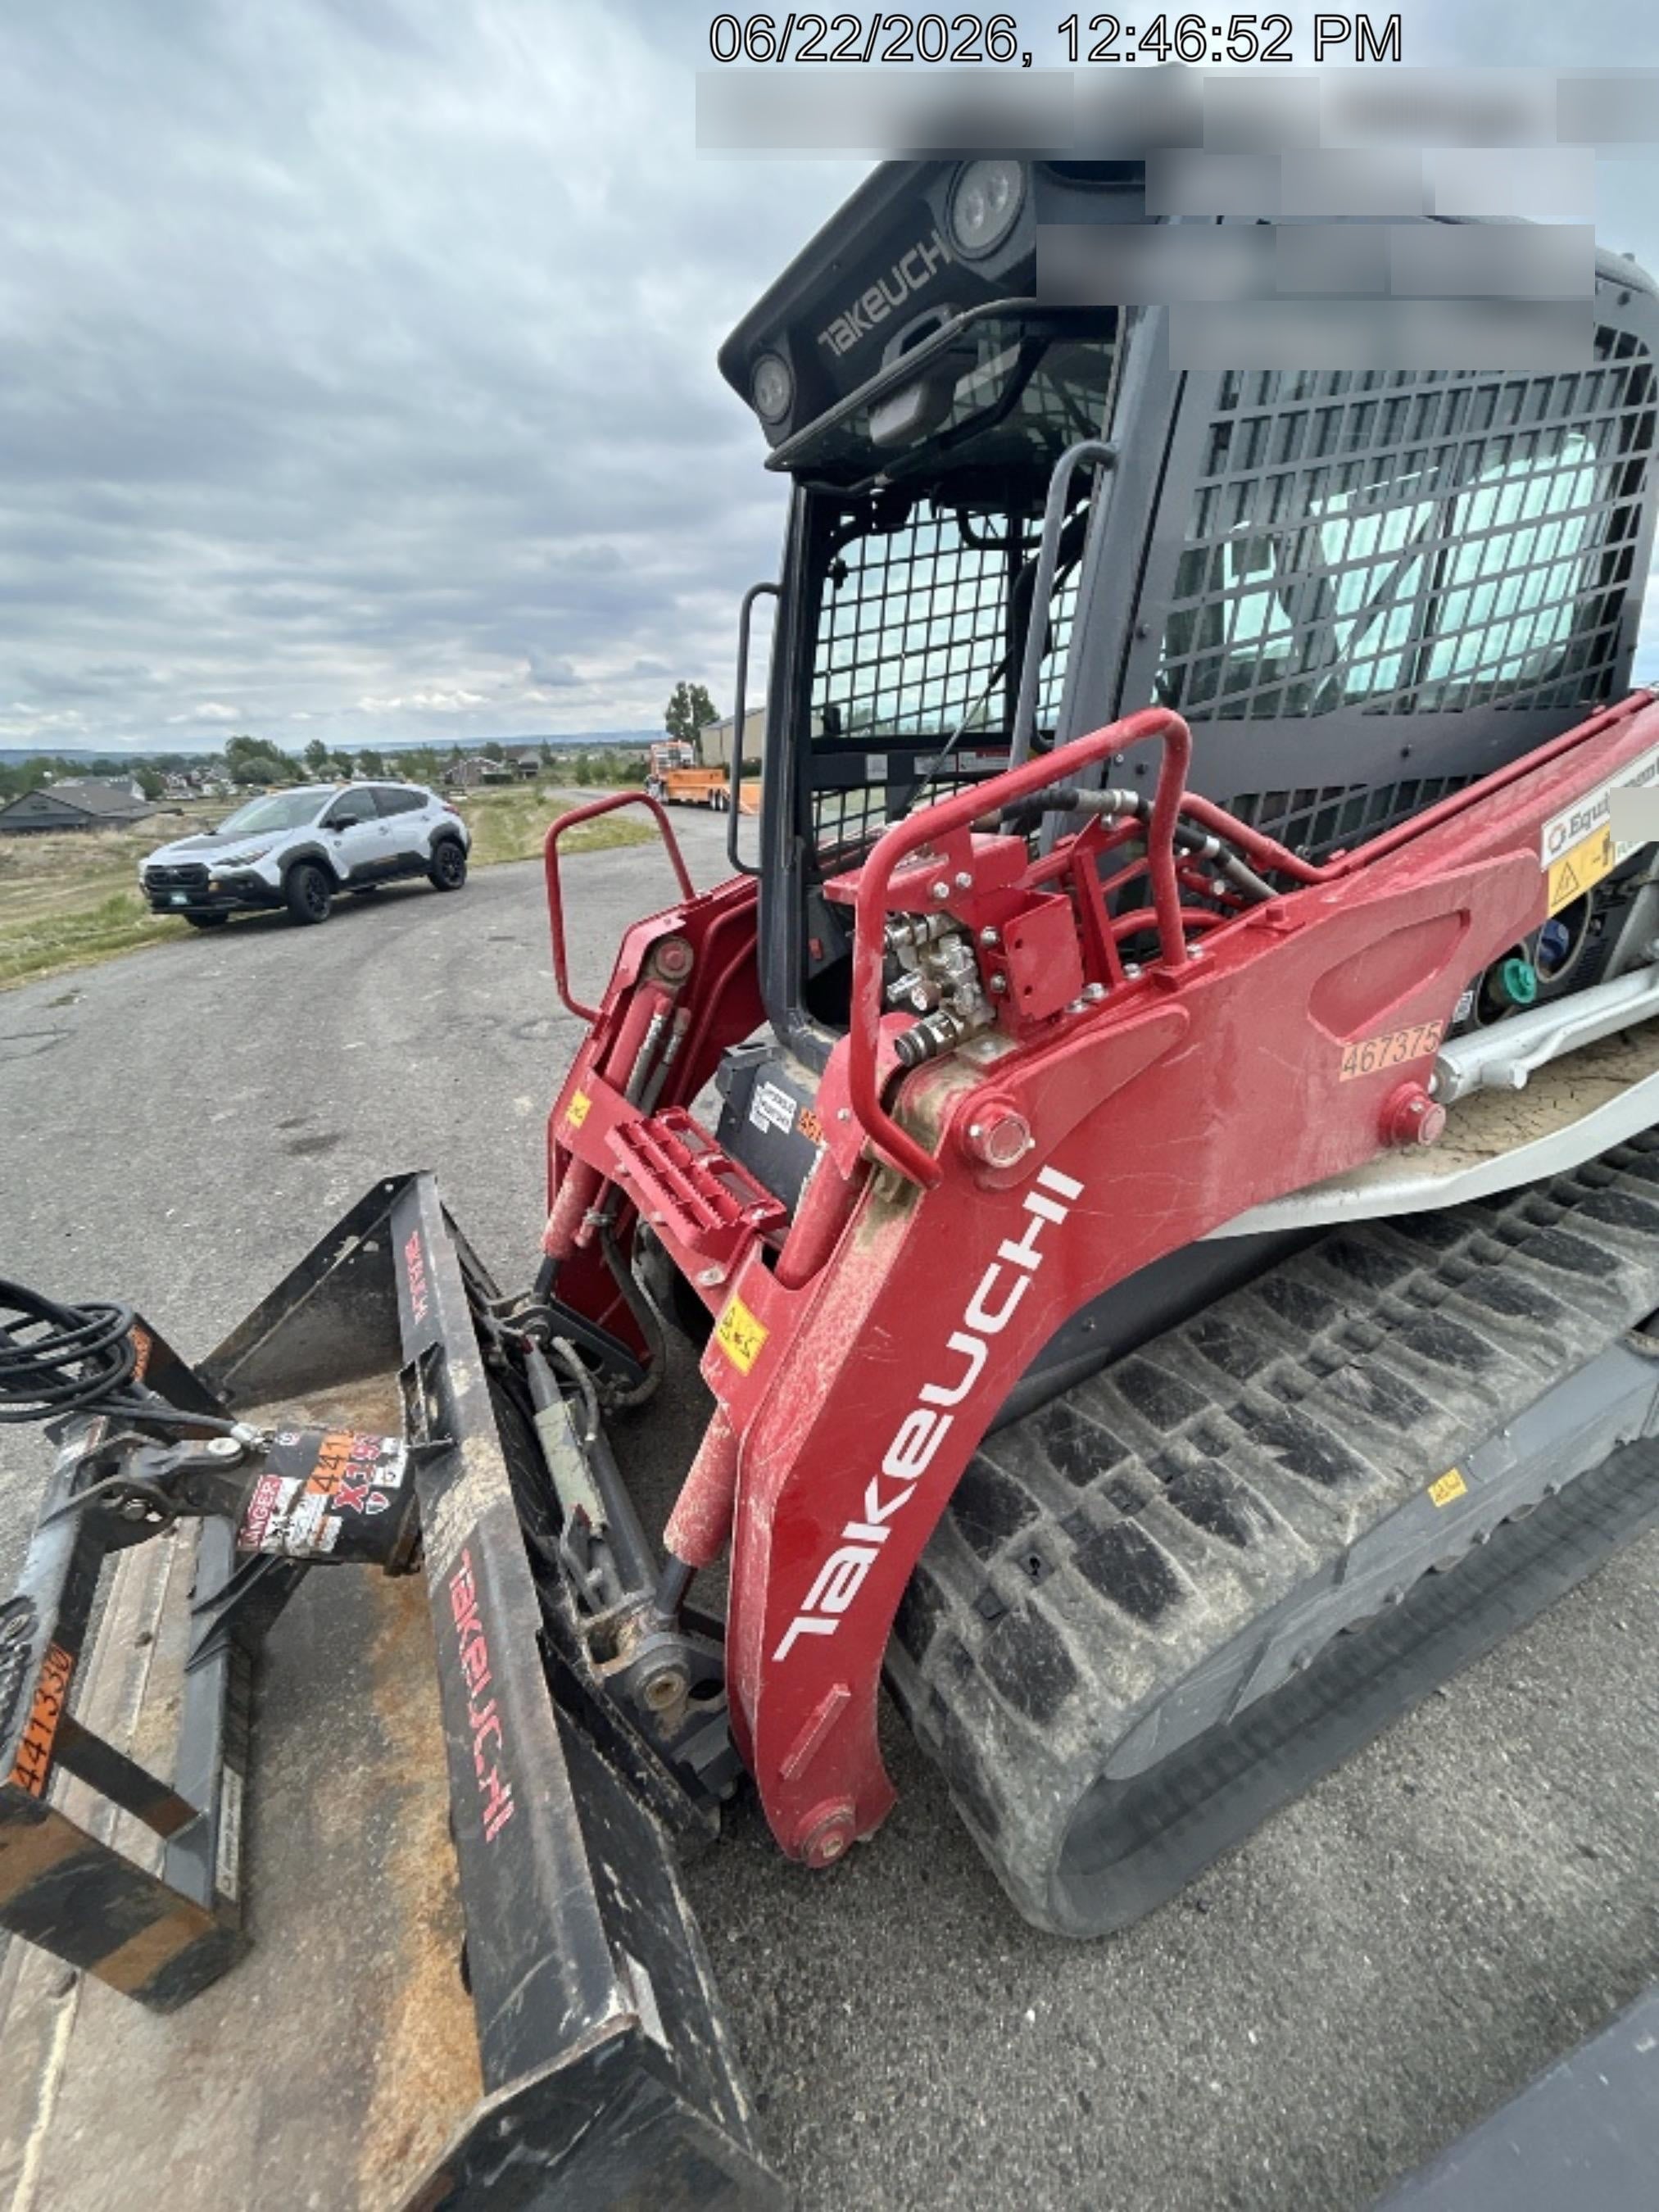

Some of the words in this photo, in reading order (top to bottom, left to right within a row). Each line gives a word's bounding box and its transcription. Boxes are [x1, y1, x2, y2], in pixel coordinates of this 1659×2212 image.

[818, 229, 953, 357] TAKEUCH
[1343, 1022, 1440, 1075] 467375
[772, 1165, 1085, 1661] TAKEUCHI
